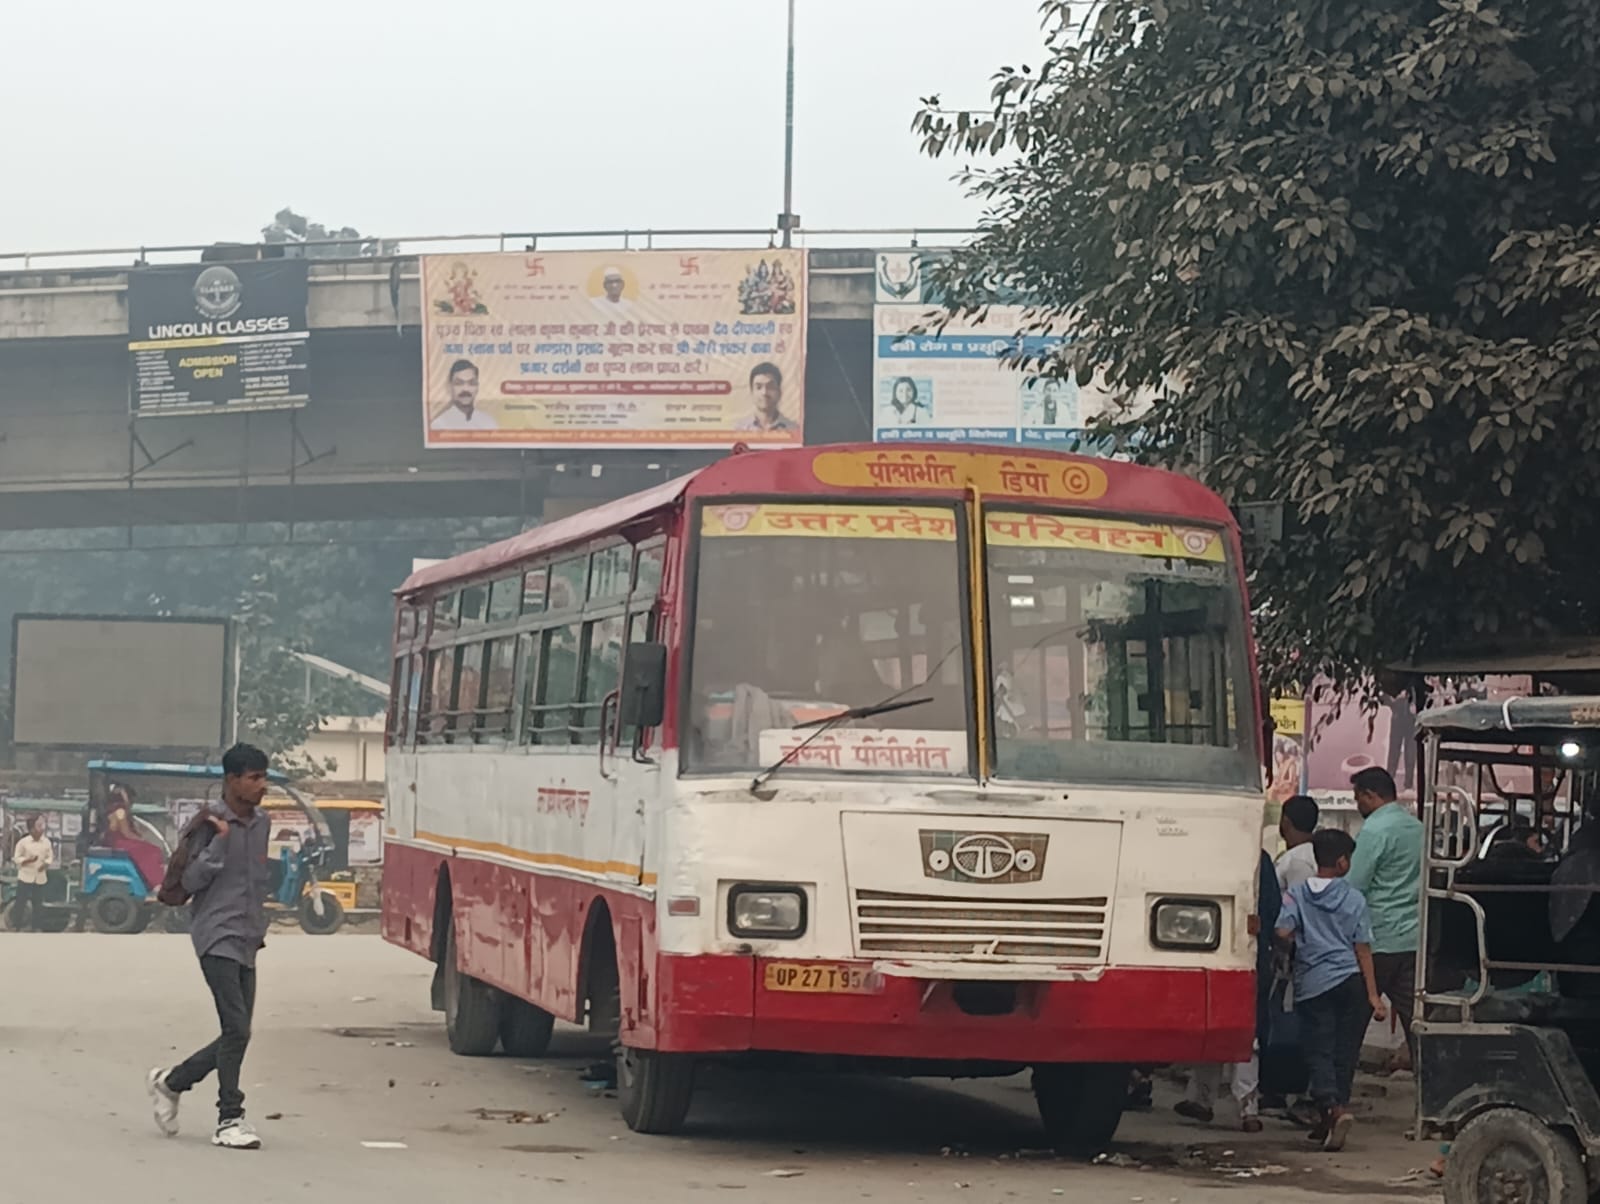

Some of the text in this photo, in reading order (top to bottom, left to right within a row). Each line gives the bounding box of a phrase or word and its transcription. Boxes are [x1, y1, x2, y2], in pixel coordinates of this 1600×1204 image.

[148, 316, 289, 339] LINCOLN CLASSES
[732, 320, 775, 336] दीपावली
[178, 355, 237, 368] ADMISSION
[193, 368, 224, 380] OPEN
[866, 453, 956, 484] पीलीभीत
[999, 461, 1050, 494] डिपो
[764, 509, 1168, 549] उत्तर प्रदेश परिवहन
[851, 735, 951, 769] पीलीभीत
[776, 967, 798, 986] UP
[801, 968, 823, 988] 27
[827, 970, 837, 988] T
